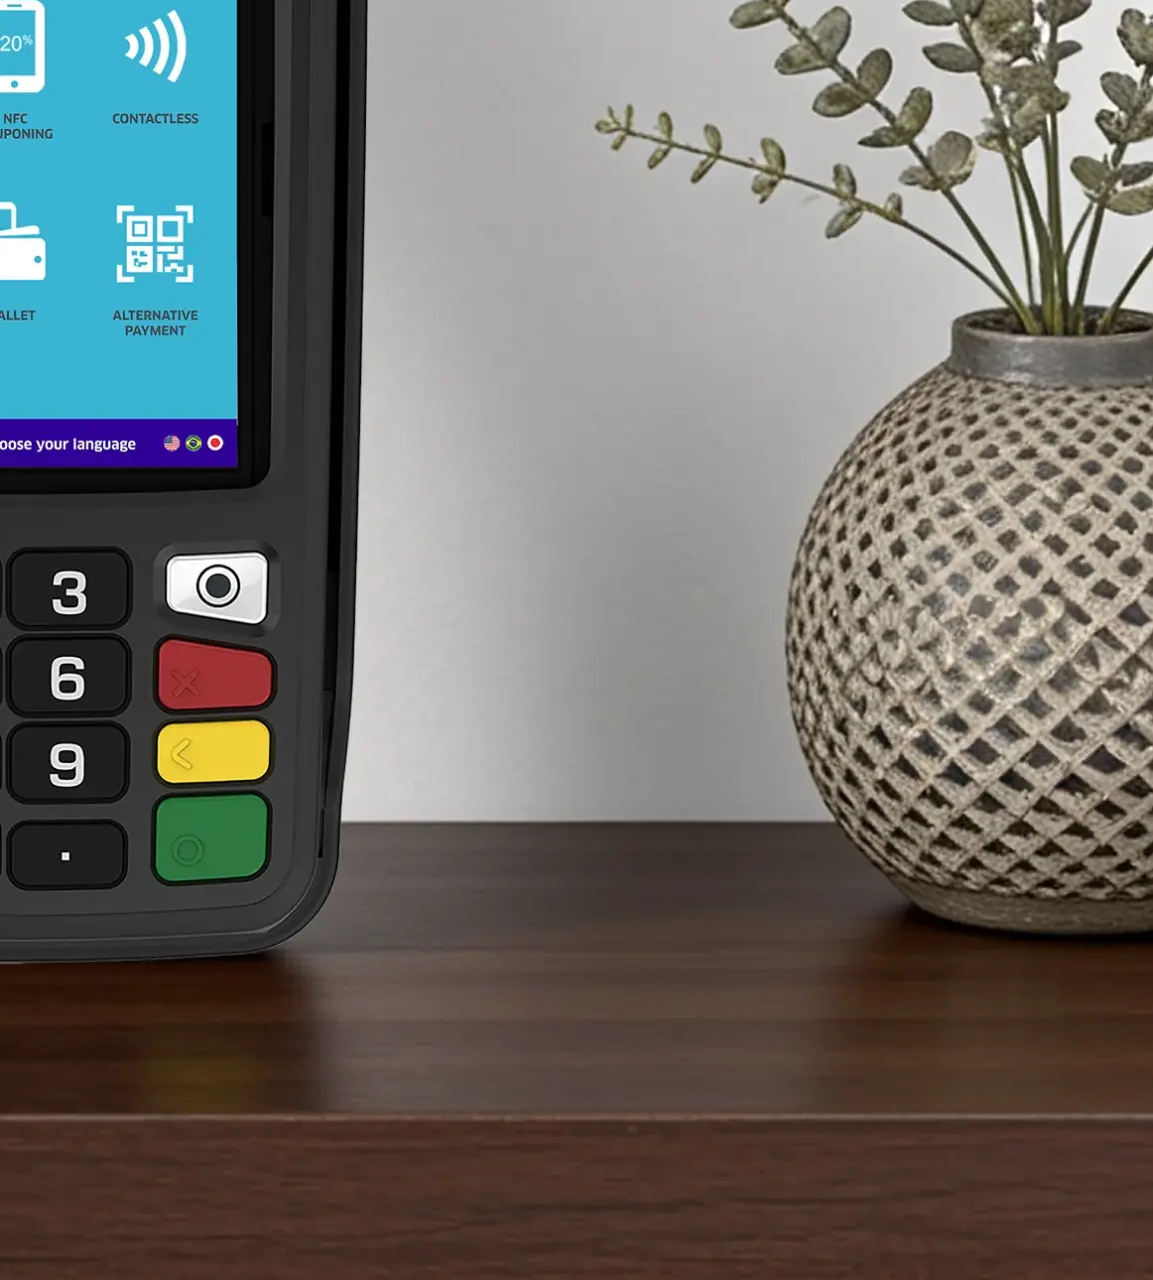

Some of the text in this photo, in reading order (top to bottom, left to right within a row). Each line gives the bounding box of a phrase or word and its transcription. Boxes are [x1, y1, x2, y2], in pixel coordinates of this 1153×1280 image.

[4, 114, 27, 123] NFC
[113, 113, 198, 124] CONTACTLESS
[113, 310, 198, 320] ALTERNATIVE
[126, 324, 186, 335] PAYMENT
[36, 440, 69, 452] your
[73, 438, 136, 452] language
[53, 571, 86, 614] 3
[51, 657, 84, 700] 6
[50, 744, 84, 787] 9
